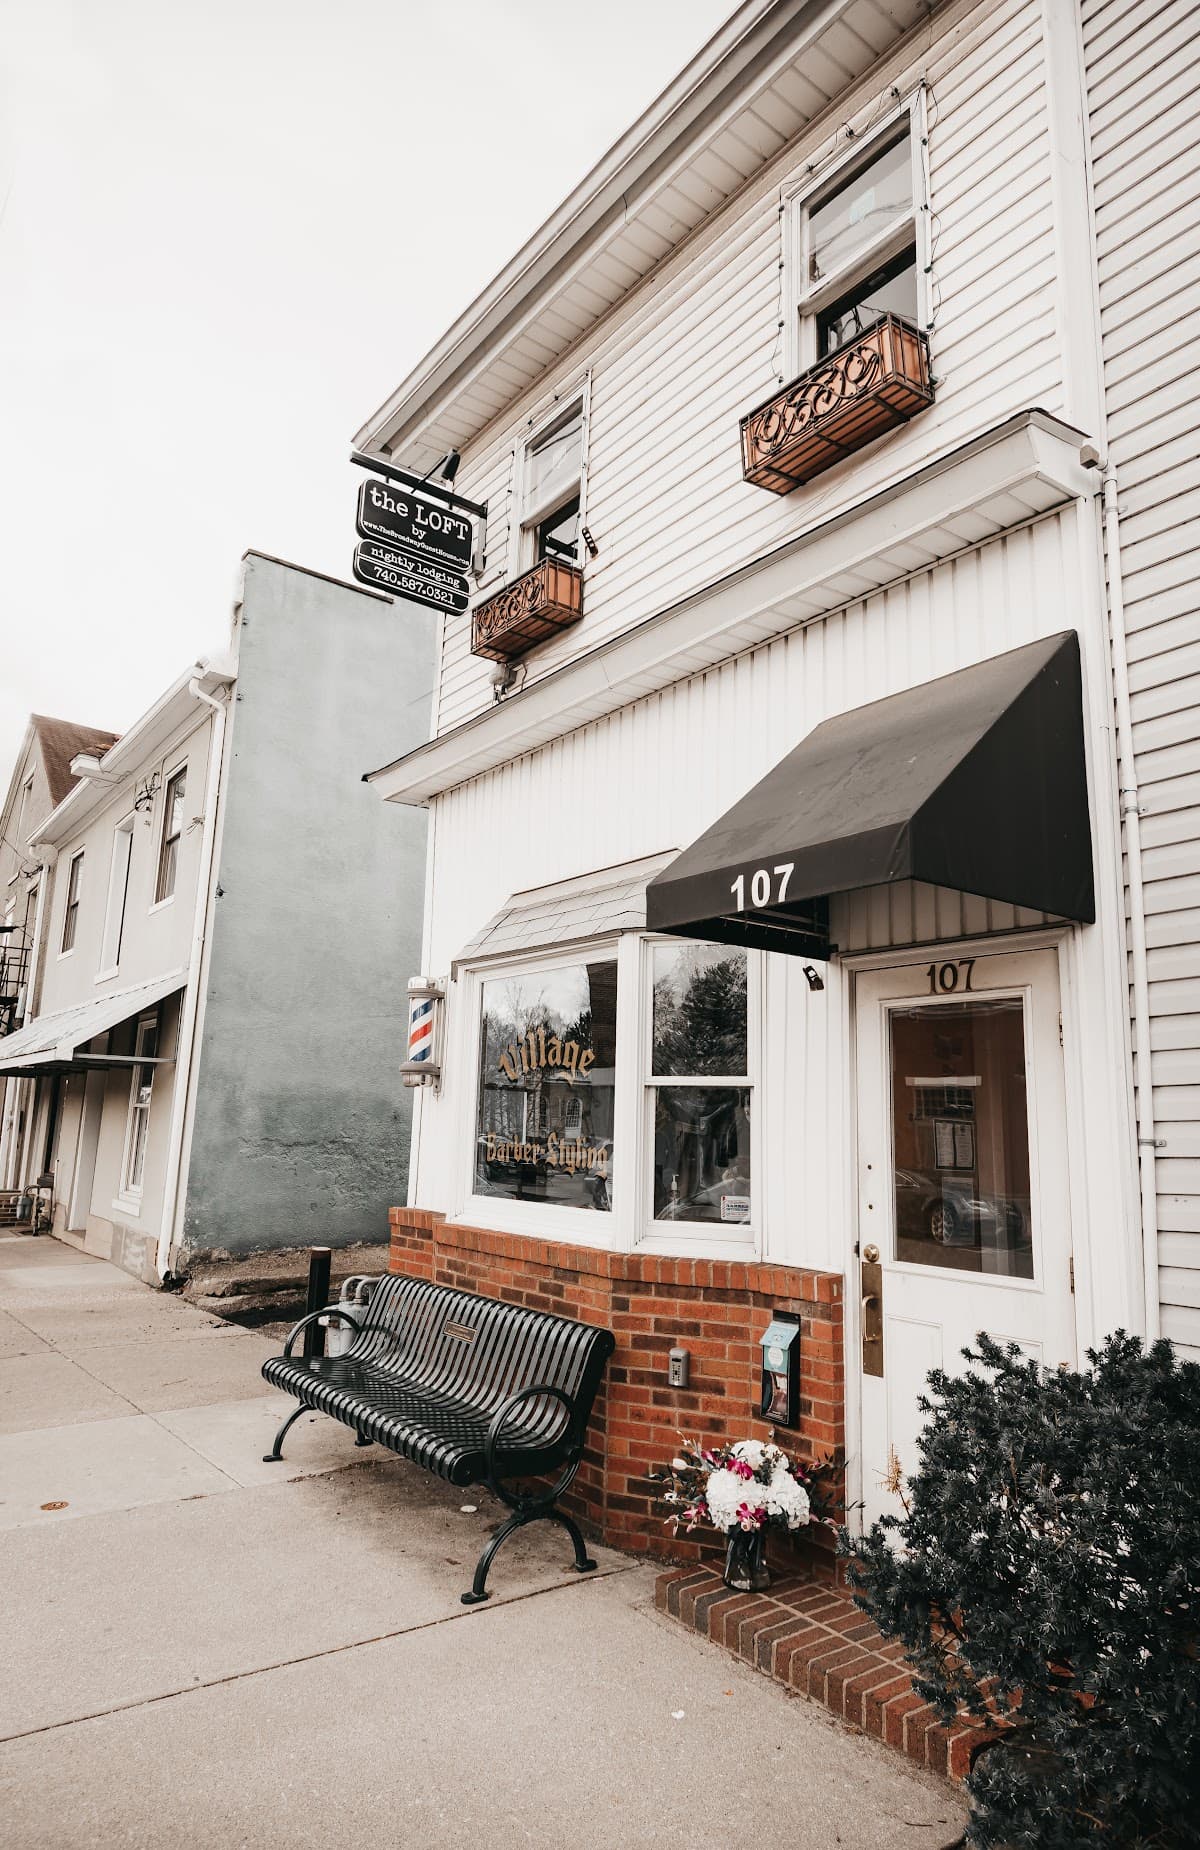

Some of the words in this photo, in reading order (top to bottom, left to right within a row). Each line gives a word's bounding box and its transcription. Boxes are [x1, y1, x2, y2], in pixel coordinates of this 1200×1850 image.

[369, 486, 409, 517] the
[415, 504, 469, 541] LOFT
[411, 524, 427, 540] by
[371, 547, 415, 571] nightly
[417, 563, 460, 588] lodging
[373, 566, 456, 605] 740.587.0321
[730, 862, 795, 912] 107
[926, 959, 976, 994] 107
[498, 1024, 596, 1087] Village
